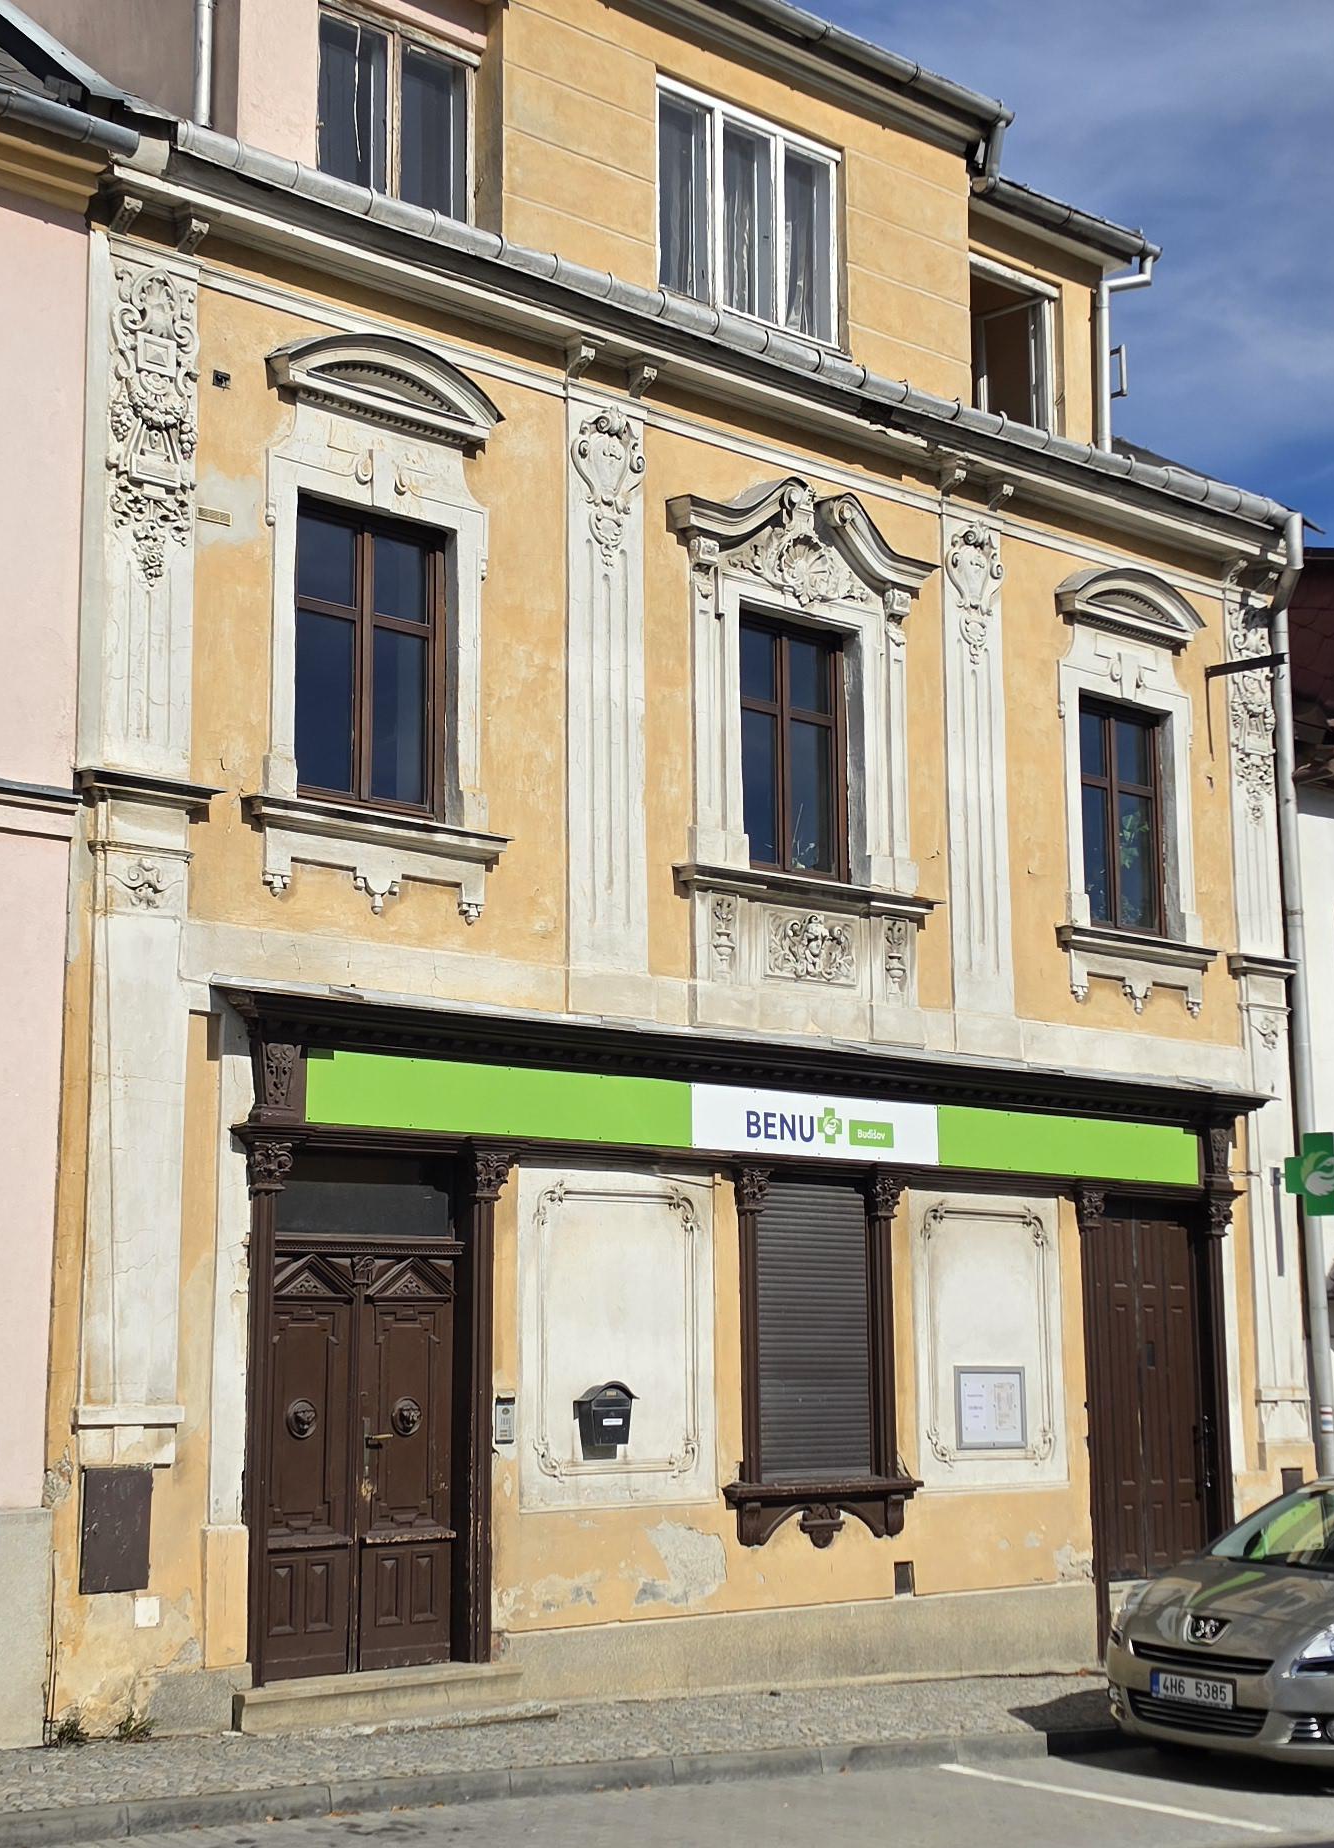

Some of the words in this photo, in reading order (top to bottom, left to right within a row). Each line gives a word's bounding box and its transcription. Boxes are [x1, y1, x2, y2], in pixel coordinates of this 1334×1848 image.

[746, 1110, 815, 1143] BENU
[857, 1128, 886, 1141] Budišov
[1162, 1676, 1186, 1696] 4H6
[1194, 1680, 1227, 1702] 5385
